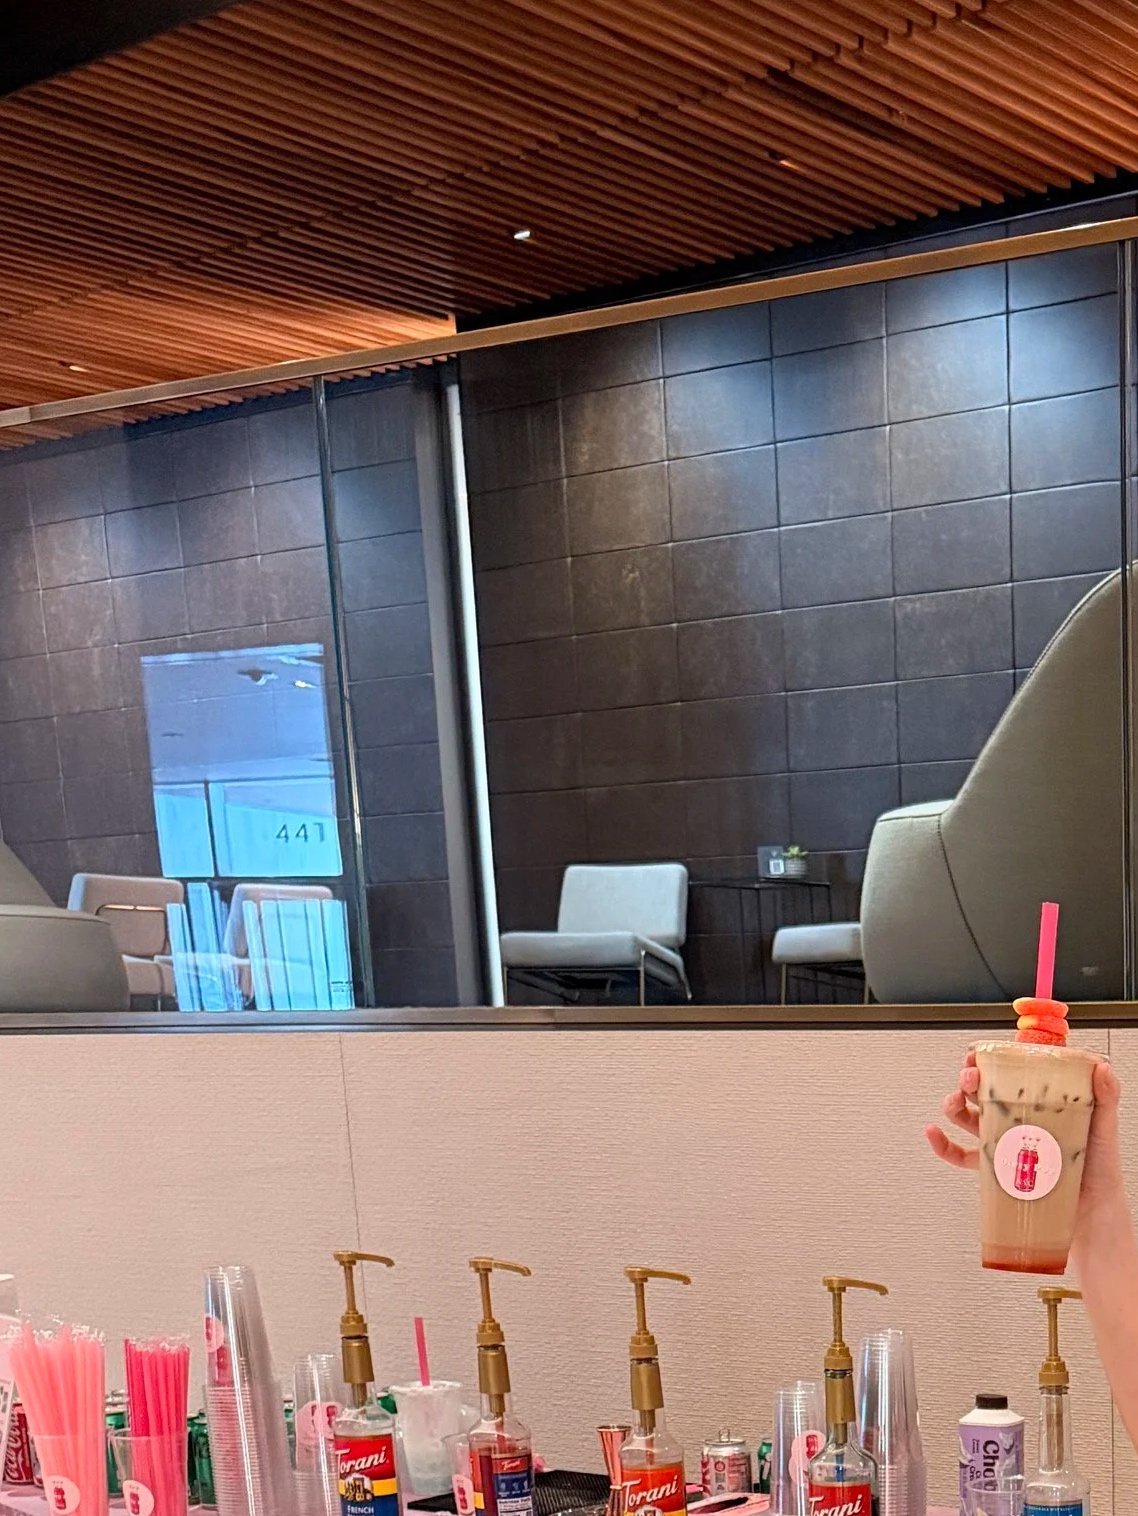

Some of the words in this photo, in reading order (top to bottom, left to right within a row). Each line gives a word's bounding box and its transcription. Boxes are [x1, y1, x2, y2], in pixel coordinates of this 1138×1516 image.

[334, 1446, 387, 1476] Torani
[621, 1475, 678, 1509] Torani
[347, 1505, 375, 1514] FRENCH
